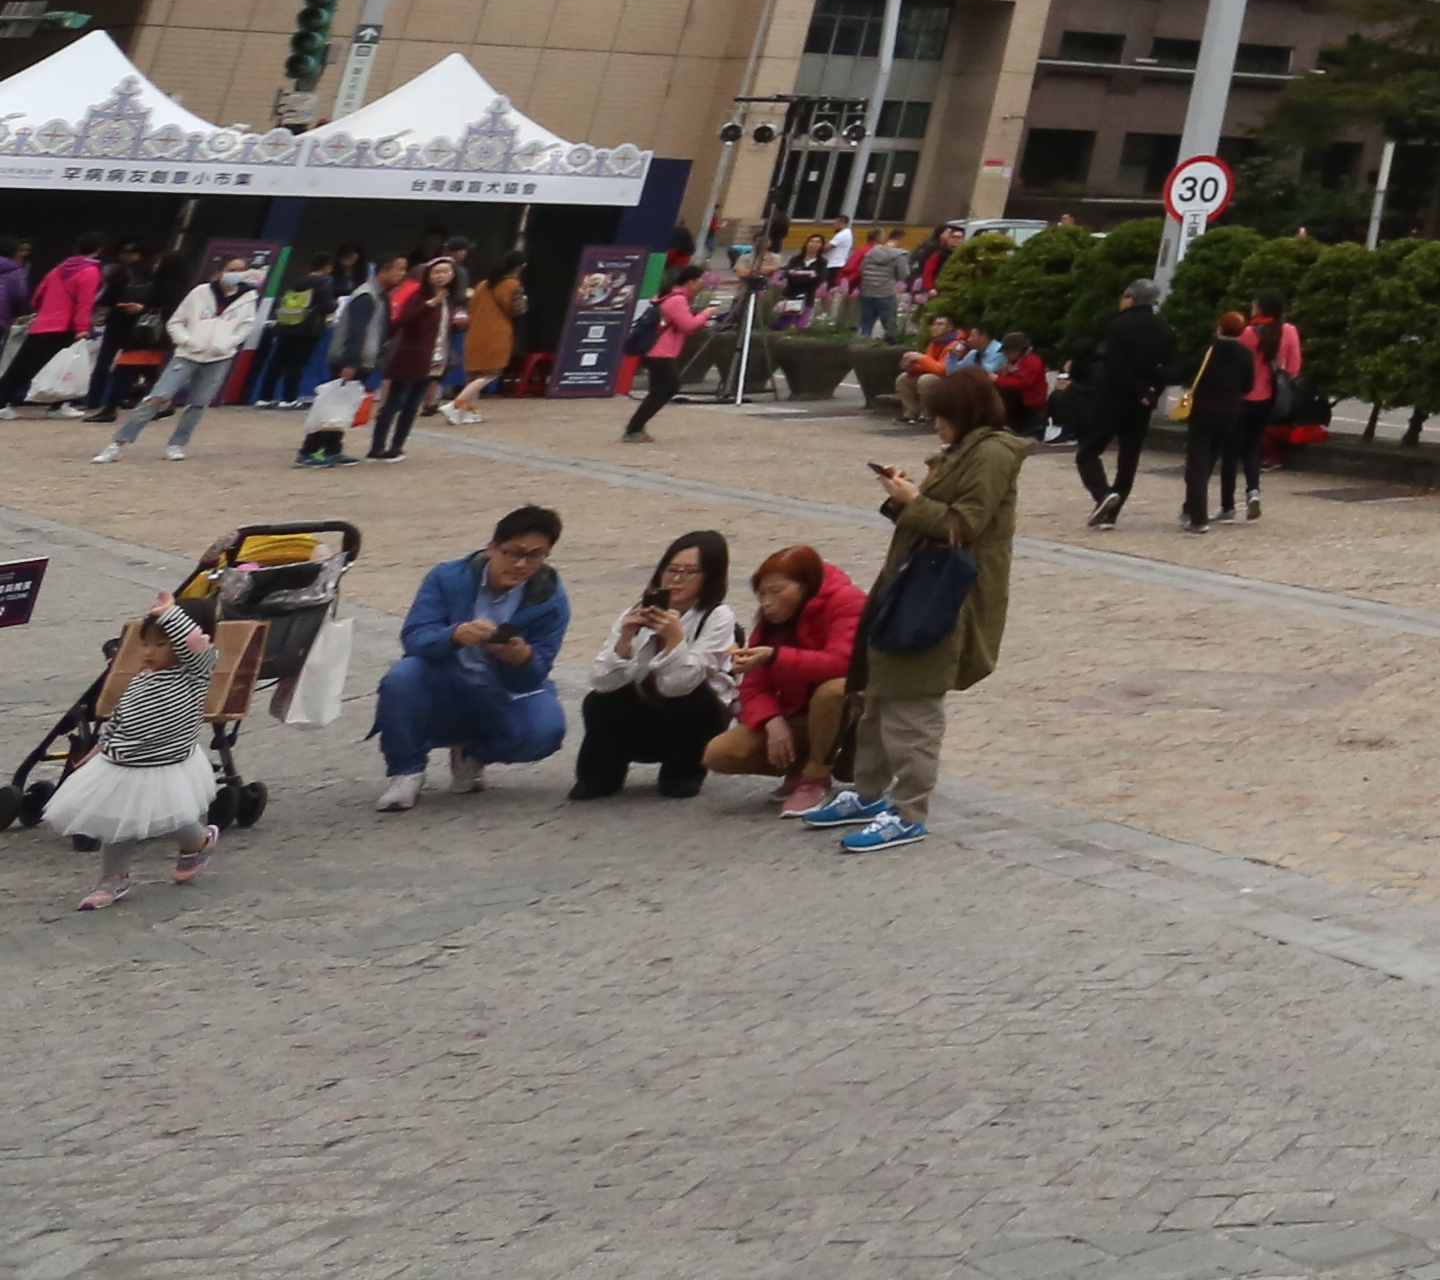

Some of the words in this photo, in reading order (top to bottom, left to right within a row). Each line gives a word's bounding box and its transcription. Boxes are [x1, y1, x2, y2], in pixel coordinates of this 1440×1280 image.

[410, 178, 538, 195] 台灣導盲犬協會
[1178, 175, 1219, 203] 30
